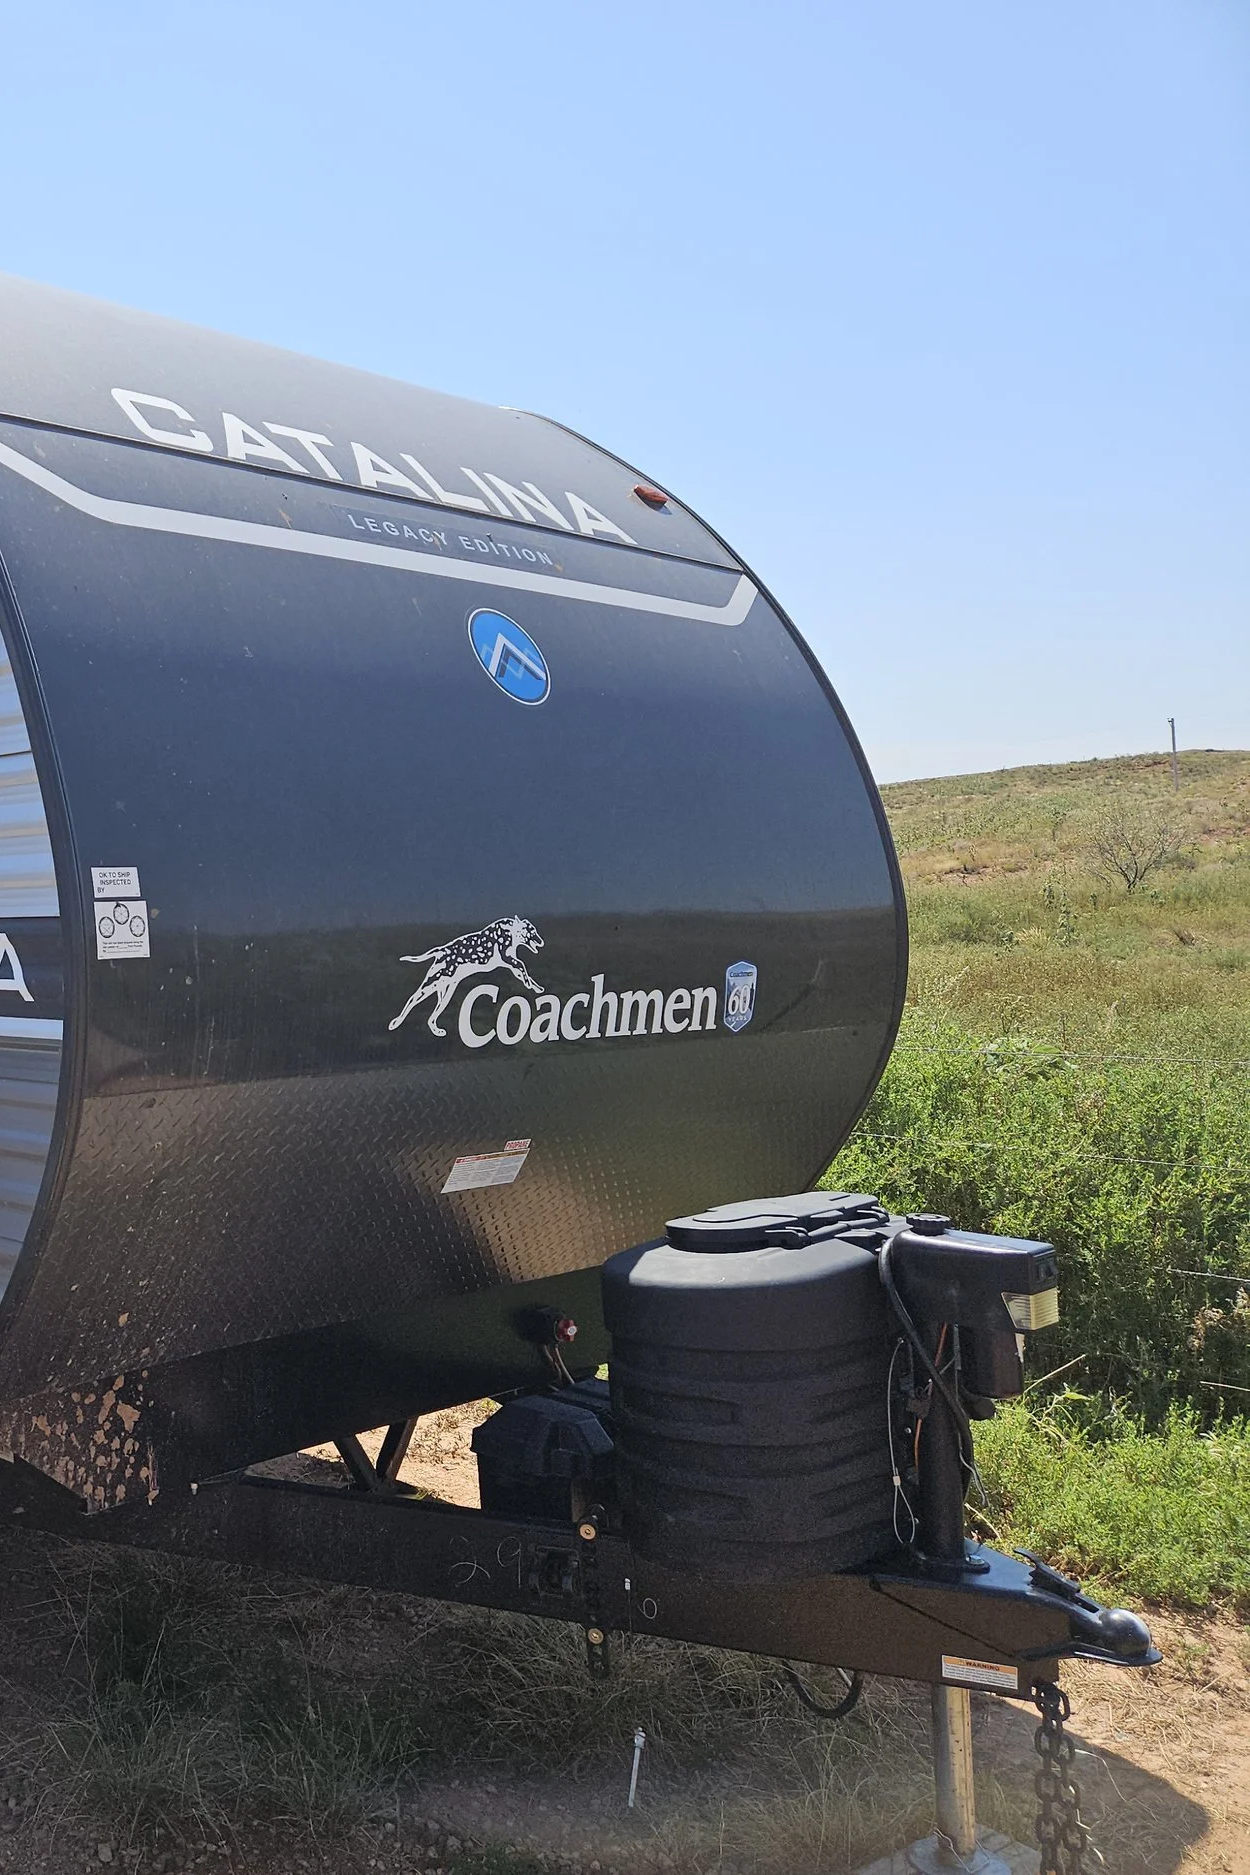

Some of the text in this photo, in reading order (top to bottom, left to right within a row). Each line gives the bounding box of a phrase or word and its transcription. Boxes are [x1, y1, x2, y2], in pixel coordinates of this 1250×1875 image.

[111, 387, 638, 545] CATALINA
[348, 514, 553, 565] LEGACY EDITION
[458, 973, 717, 1048] Coachmen
[727, 984, 751, 1015] 60
[965, 1660, 1000, 1671] WARNING
